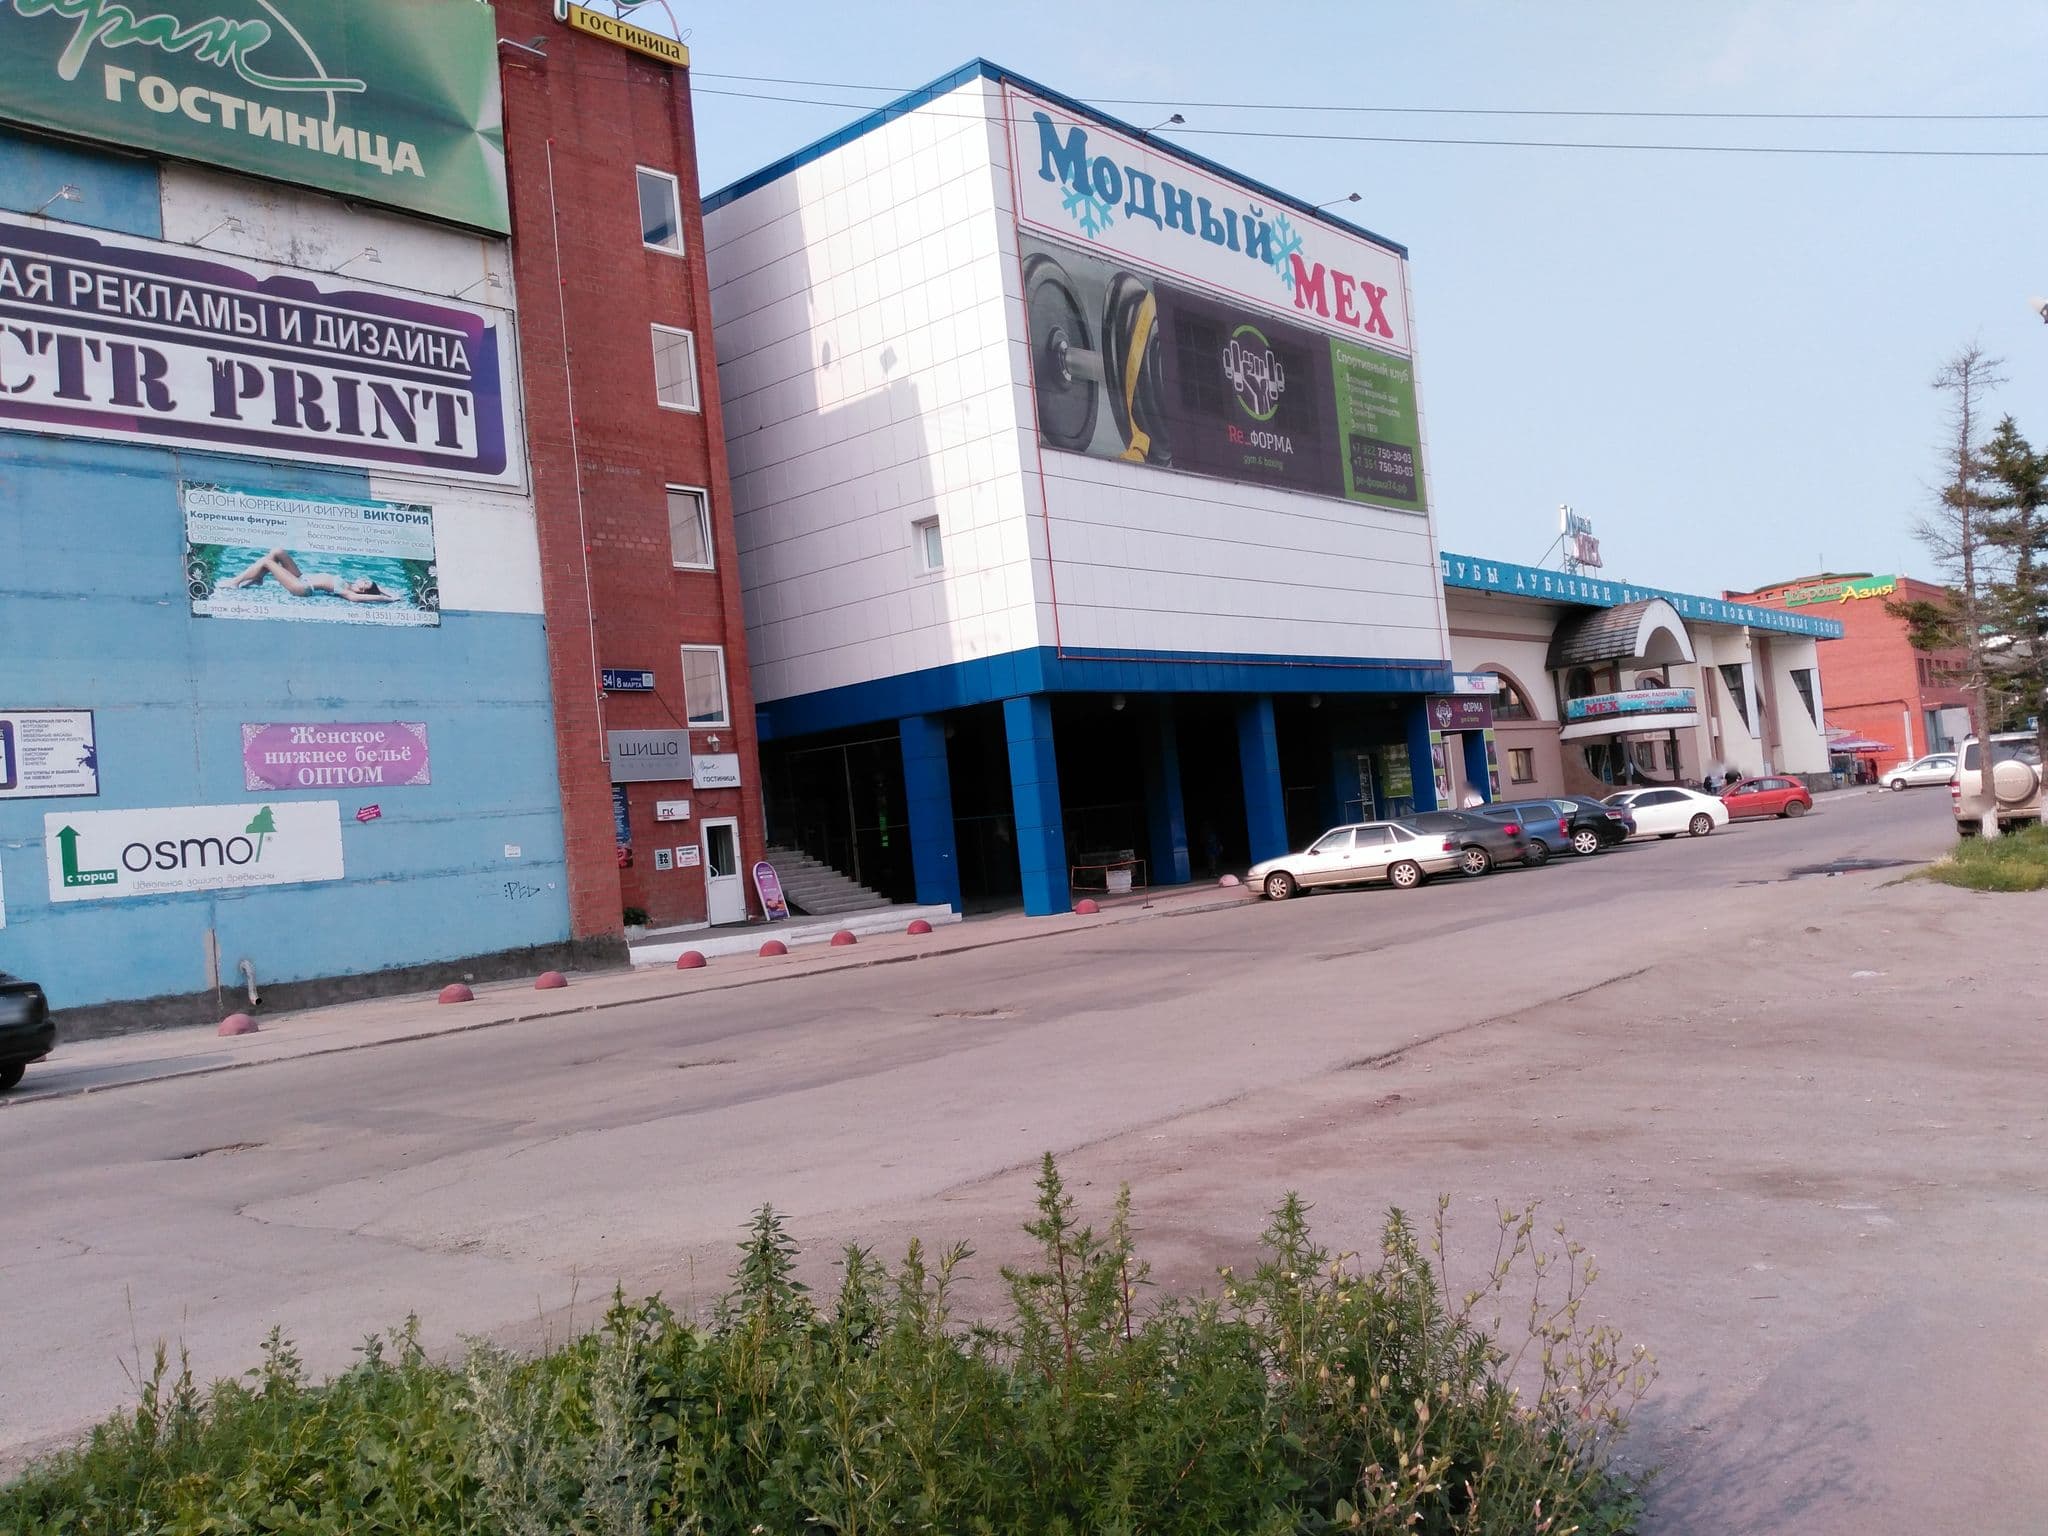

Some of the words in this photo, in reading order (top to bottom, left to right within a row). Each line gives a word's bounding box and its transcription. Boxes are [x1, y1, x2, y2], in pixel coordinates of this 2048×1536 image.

[104, 64, 425, 178] ГОСТИНИЦА
[1290, 253, 1394, 339] МЕХ
[68, 269, 268, 337] РЕКЛАМЫ
[280, 306, 303, 342] И
[313, 313, 472, 372] ДИЗАЙНА
[207, 355, 470, 451] PRINT
[1378, 447, 1412, 464] 750-30-03
[1379, 461, 1414, 477] 750-30-03
[188, 493, 238, 509] САЛОН
[240, 496, 311, 516] КОРРЕКЦИИ
[313, 505, 360, 520] ФИГУРЫ
[363, 509, 430, 526] ВИКТОРИЯ
[189, 510, 245, 522] Коррекция
[246, 515, 288, 526] фигуры:
[1840, 583, 1894, 604] Азия
[253, 605, 269, 615] 315
[603, 675, 613, 687] 54
[616, 677, 622, 689] 8
[1584, 700, 1620, 714] МЕХ
[290, 726, 386, 745] Женское
[264, 750, 348, 765] нижнее
[354, 746, 413, 763] бельё
[298, 766, 384, 786] ОПТОМ
[121, 836, 254, 872] osmo
[76, 871, 115, 885] торца
